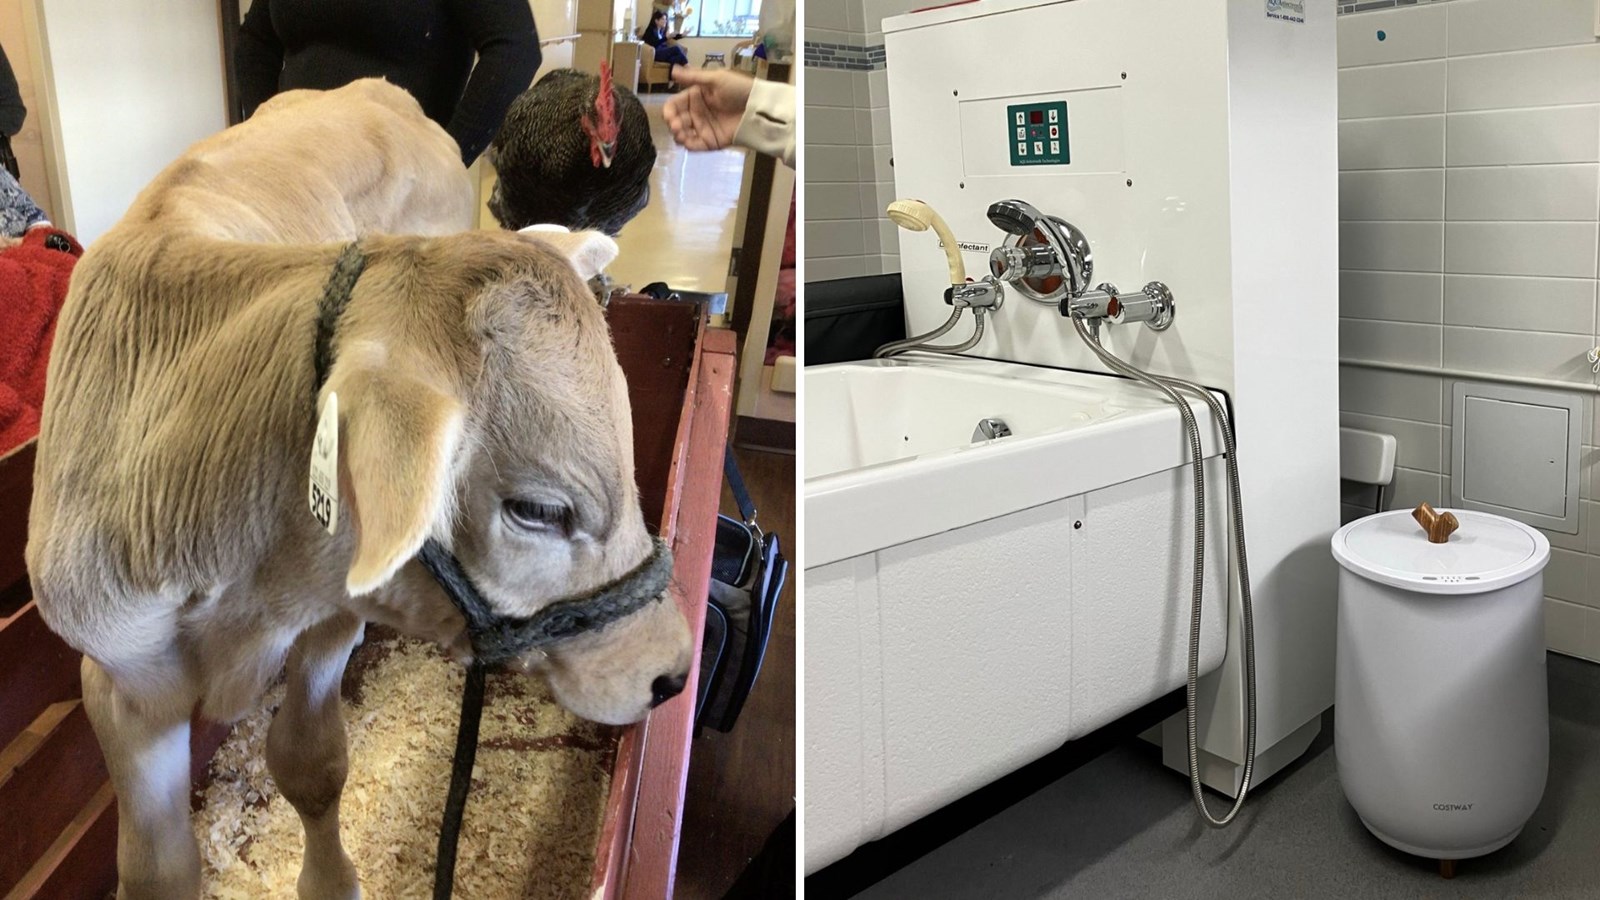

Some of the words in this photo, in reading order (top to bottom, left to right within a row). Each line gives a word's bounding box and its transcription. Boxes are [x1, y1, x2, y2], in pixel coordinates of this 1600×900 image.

[939, 241, 988, 252] Dnfectant
[312, 482, 331, 528] 5219
[1432, 803, 1473, 811] COSTWAY
